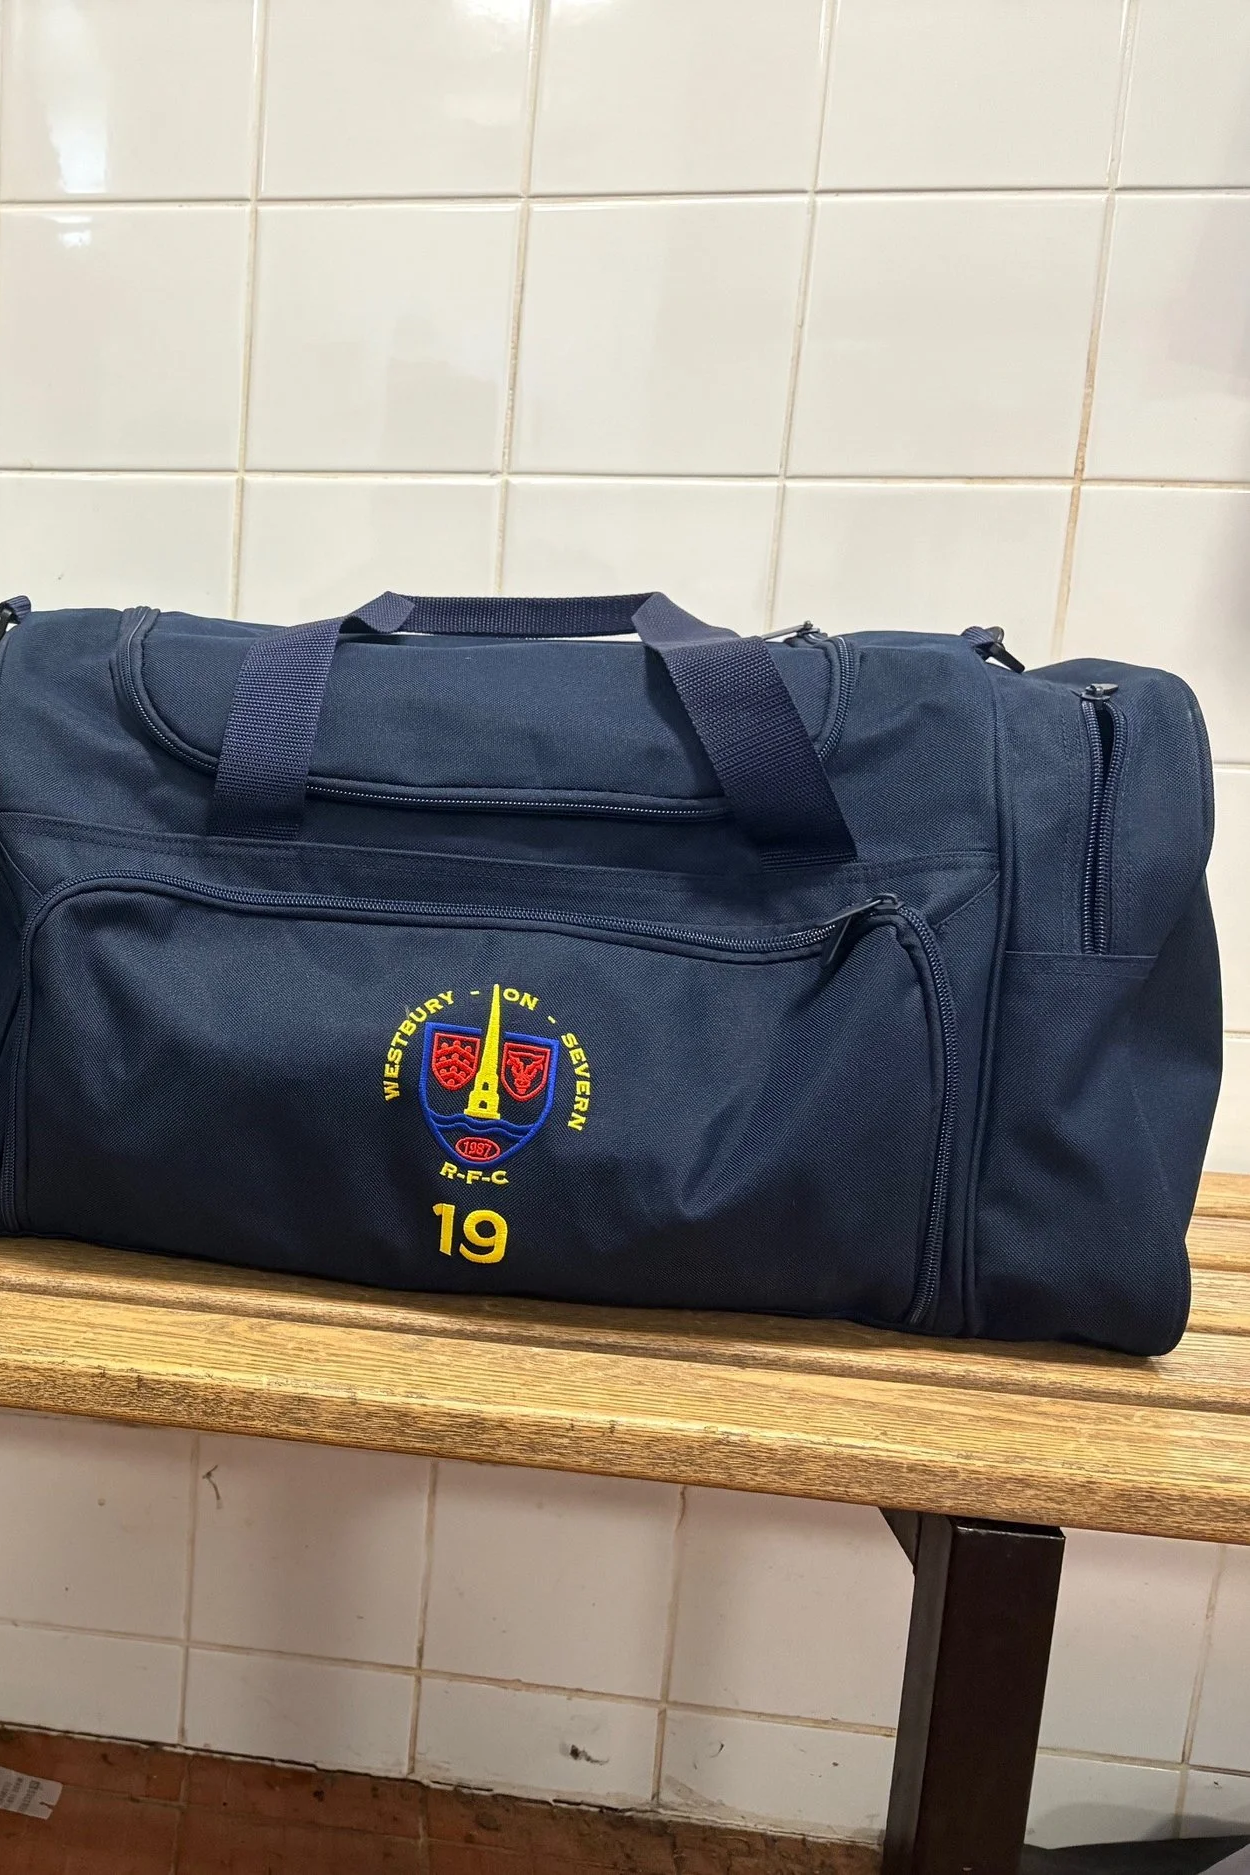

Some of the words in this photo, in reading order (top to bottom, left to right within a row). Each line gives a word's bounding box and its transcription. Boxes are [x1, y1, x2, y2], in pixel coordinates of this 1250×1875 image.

[383, 990, 455, 1101] WESTBURY
[503, 988, 539, 1010] ON
[561, 1032, 592, 1131] SEVERN
[463, 1141, 492, 1158] 1987
[439, 1161, 509, 1185] R-F-C
[432, 1202, 508, 1264] 19
